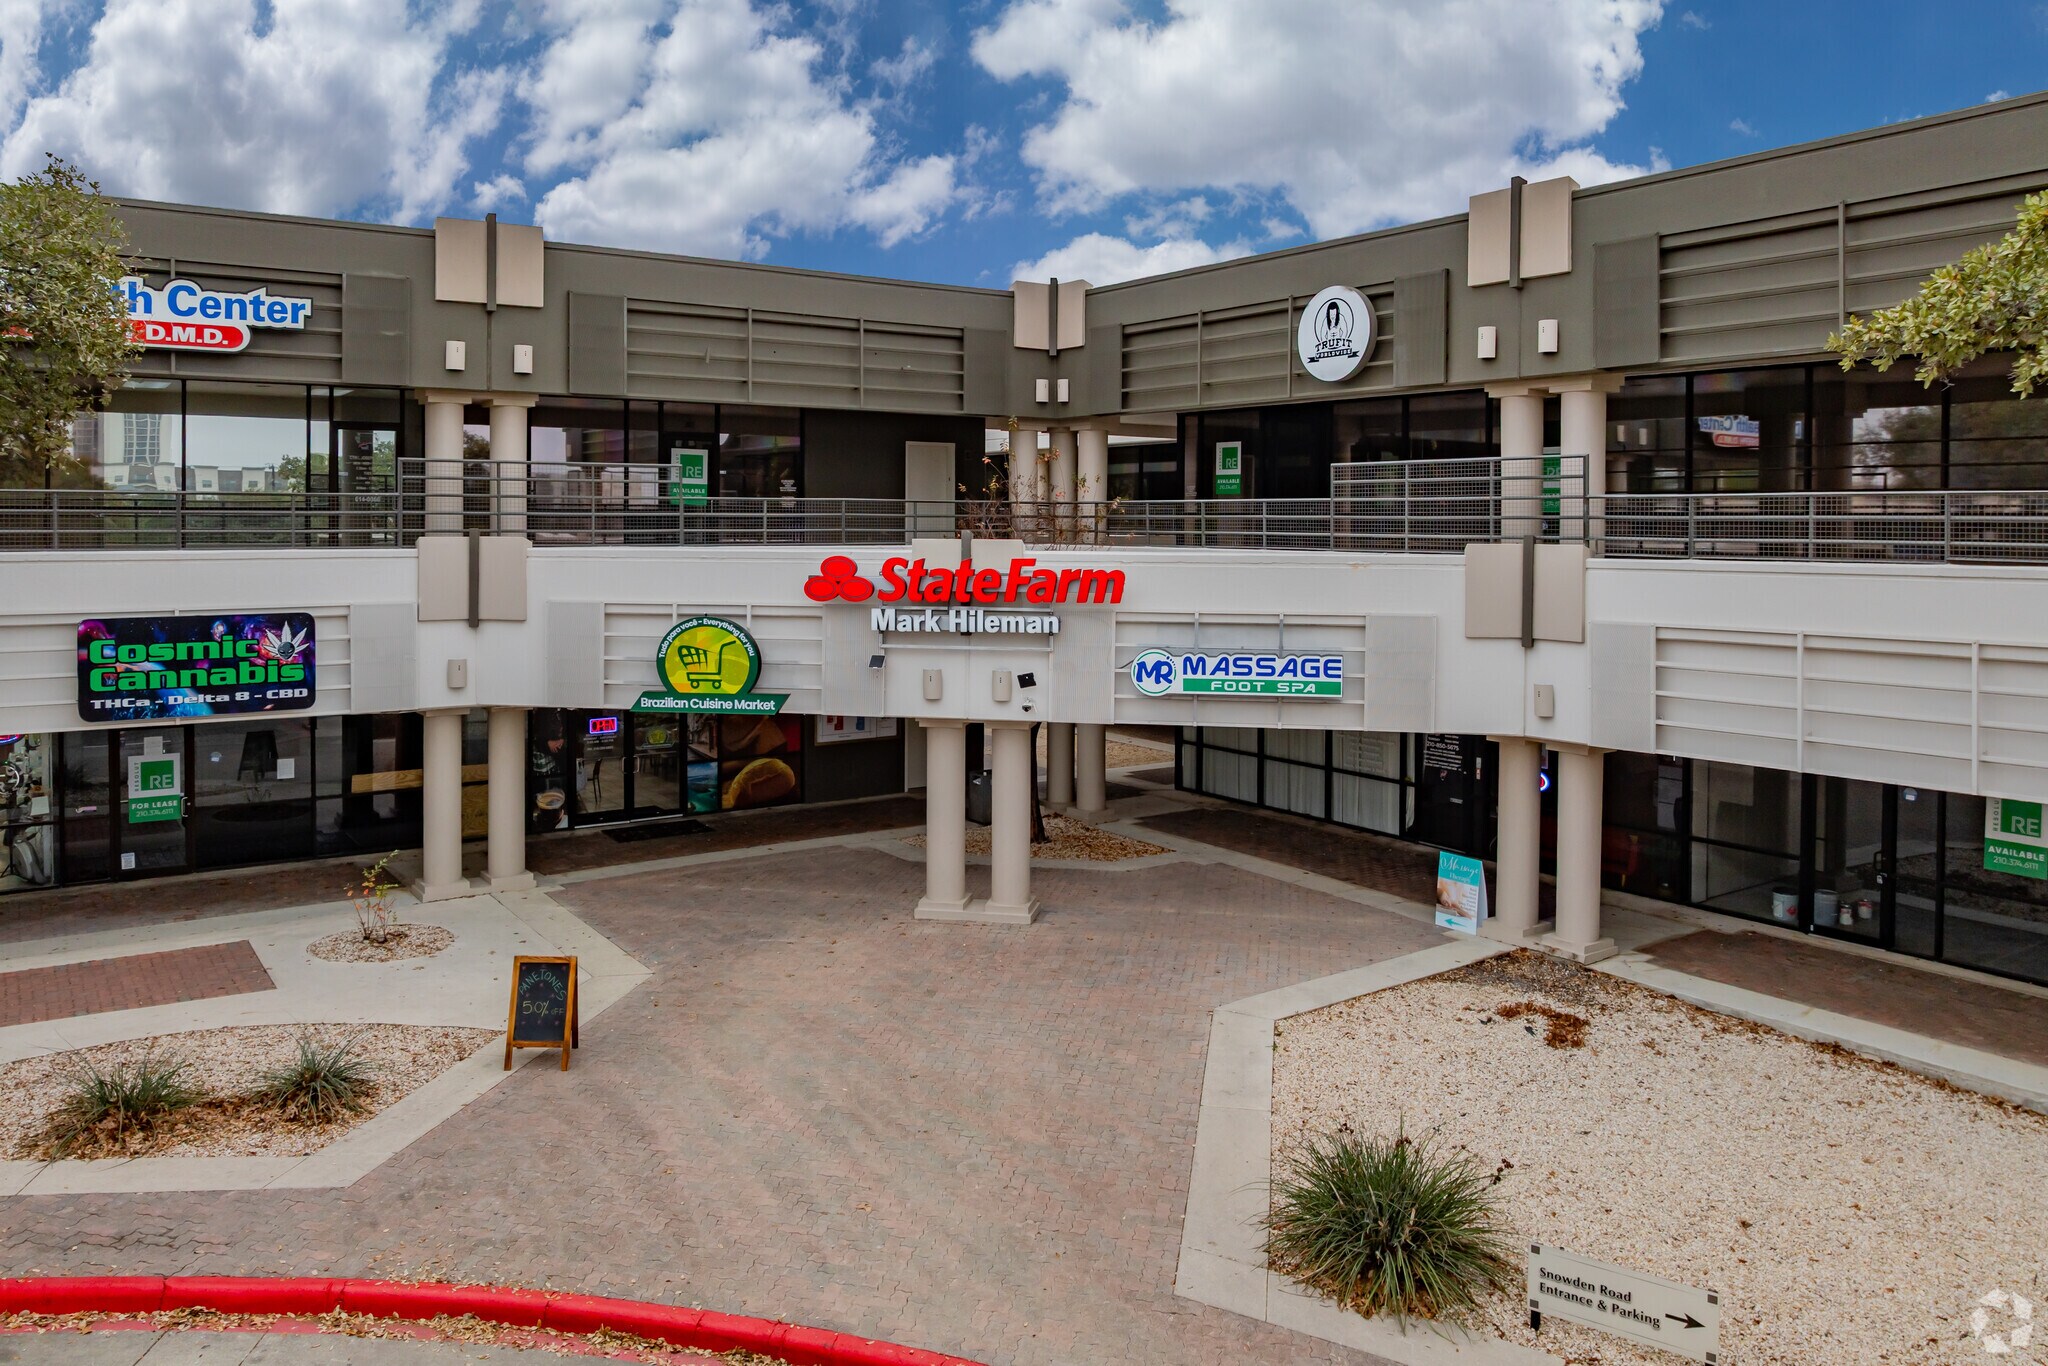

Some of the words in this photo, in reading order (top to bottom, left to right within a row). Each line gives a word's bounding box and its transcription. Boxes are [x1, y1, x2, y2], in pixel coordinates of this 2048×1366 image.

[167, 284, 307, 324] Center
[145, 323, 230, 345] D.M.D.
[1315, 338, 1353, 352] TRUFIT
[685, 465, 702, 478] RE
[1225, 457, 1238, 469] RE
[871, 608, 942, 633] Mark
[949, 609, 1061, 635] Hileman
[658, 640, 670, 658] Tudo
[666, 626, 682, 643] para
[703, 618, 741, 637] Everything
[738, 631, 749, 643] for
[744, 640, 755, 657] you
[89, 635, 259, 665] Cosmic
[89, 660, 306, 693] Cannabis
[1135, 659, 1174, 684] MR
[1182, 656, 1342, 679] MASSAGE
[1210, 680, 1266, 692] FOOT
[1276, 682, 1317, 694] SPA
[90, 697, 151, 710] THCa
[168, 692, 231, 706] Delta
[235, 691, 250, 702] 8
[266, 687, 309, 700] CBD
[640, 697, 689, 709] Brazilian
[689, 698, 734, 710] Cuisine
[734, 699, 776, 711] Market
[591, 718, 616, 732] OPEN
[149, 773, 173, 789] RE
[131, 801, 150, 810] FOR
[152, 799, 179, 808] LEASE
[2010, 815, 2040, 837] RE
[1987, 844, 2046, 863] AVAILABLE
[518, 968, 567, 1001] PANETONES
[522, 1000, 550, 1017] 50%
[1540, 1266, 1596, 1293] Snowden
[1600, 1284, 1632, 1304] Road
[1540, 1282, 1593, 1307] Entrance
[1597, 1299, 1607, 1312] &
[1611, 1303, 1661, 1331] Parking
